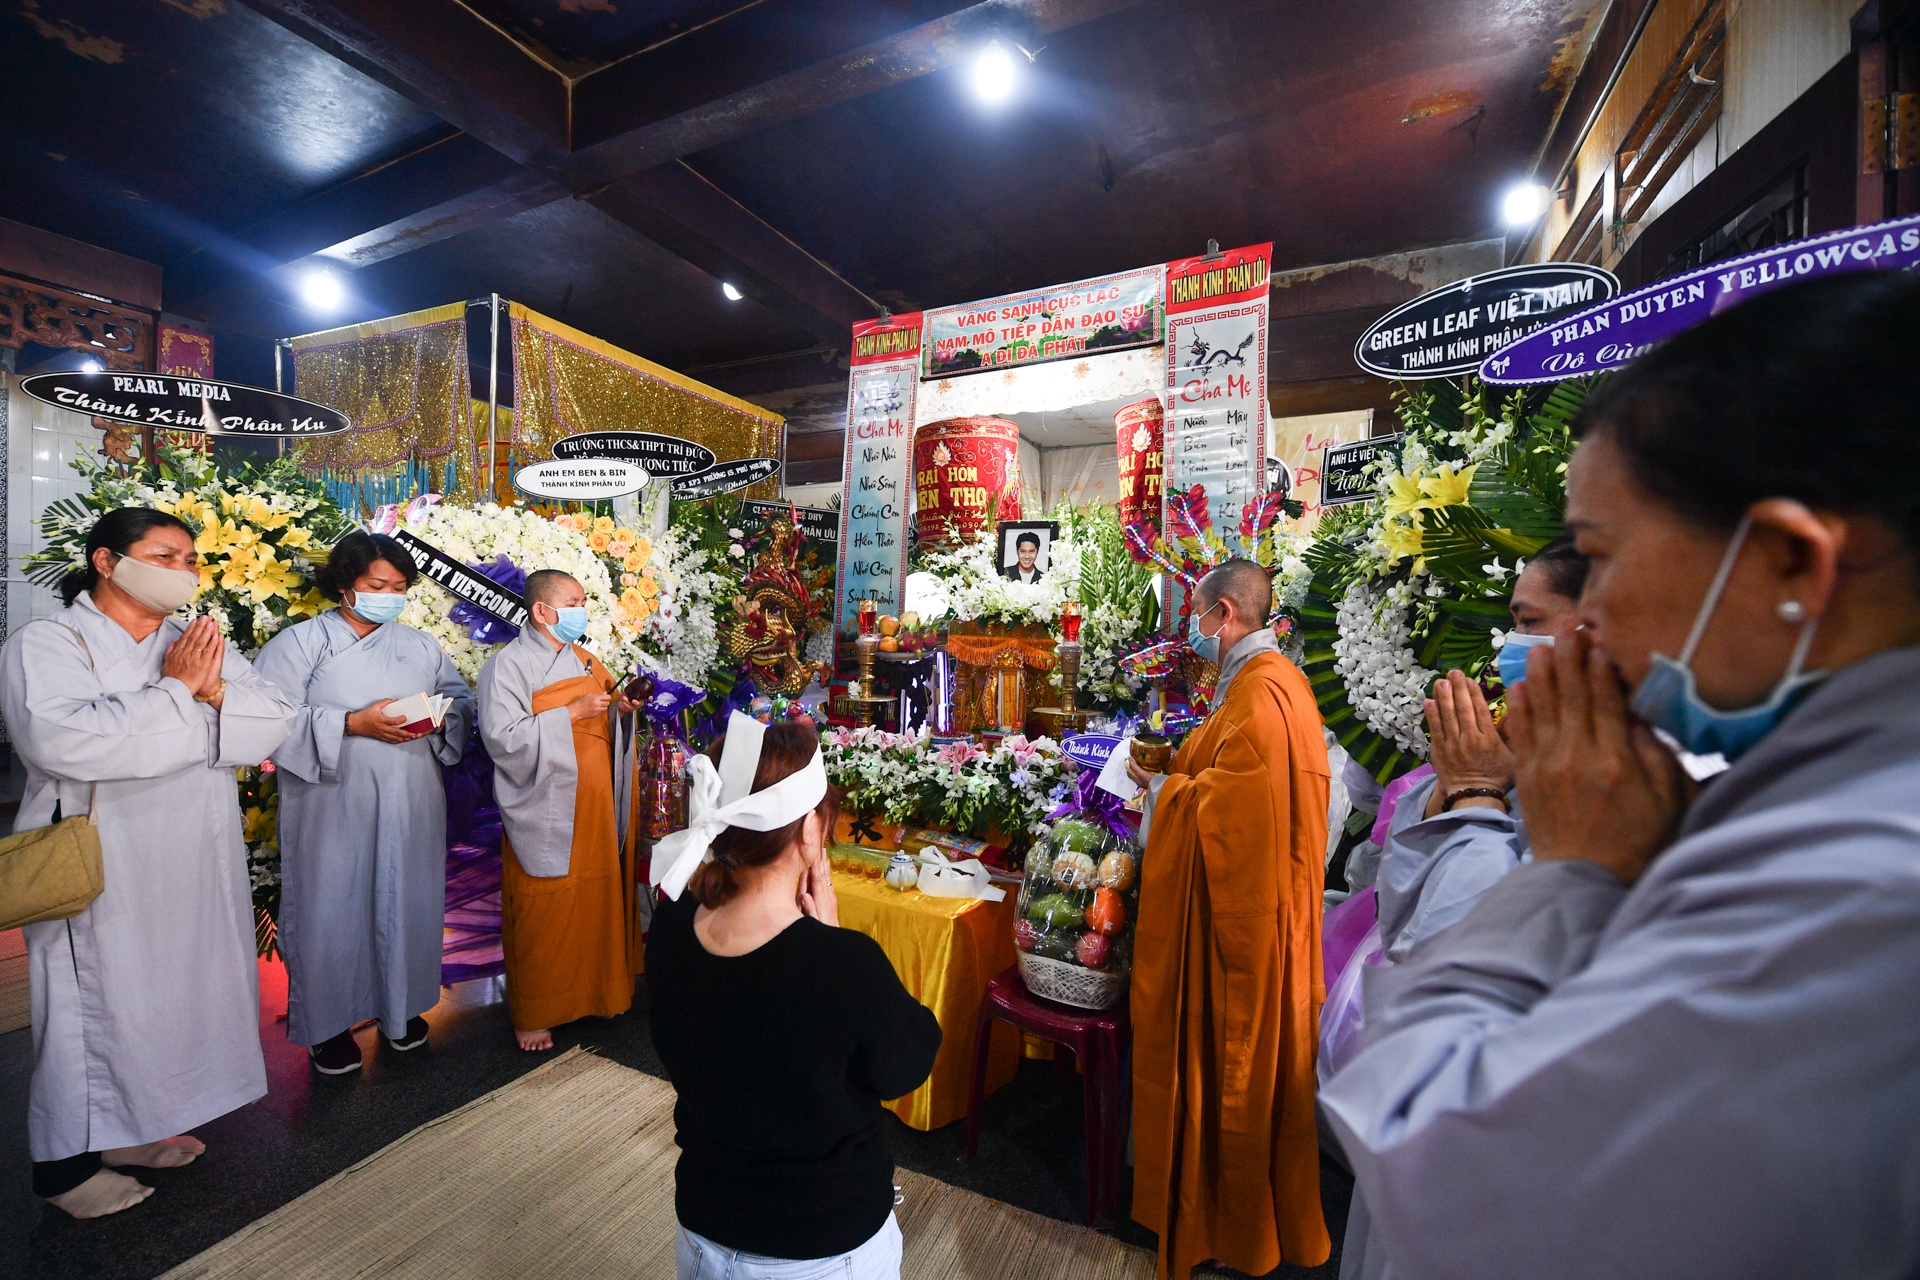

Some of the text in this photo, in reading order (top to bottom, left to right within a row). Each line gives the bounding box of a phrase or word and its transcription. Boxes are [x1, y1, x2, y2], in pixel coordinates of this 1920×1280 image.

[1171, 270, 1200, 304] THÀNH
[1203, 265, 1224, 298] KÍNH
[1226, 258, 1251, 294] PHÂN
[957, 285, 1120, 328] VÃNG SANH CỰC LẠC
[1370, 277, 1595, 352] GREEN LEAF VIỆT NAM
[1550, 312, 1611, 347] PHAN
[1619, 279, 1705, 325] DUYEN
[876, 328, 891, 355] KÍNH
[891, 325, 908, 353] PHÂN
[936, 335, 967, 353] NAM
[972, 329, 996, 346] MÔ
[1001, 320, 1037, 342] TIẾP
[1042, 313, 1075, 334] DẪN
[1081, 309, 1116, 330] ĐẠO
[981, 352, 992, 366] A
[996, 349, 1012, 364] DI
[1017, 342, 1039, 361] ĐÀ
[1402, 341, 1443, 370] THÀNH
[1447, 336, 1479, 362] KÍNH
[1542, 351, 1587, 374] Vô
[112, 376, 232, 401] PEARL MEDIA
[1180, 374, 1253, 403] Cha Mẹ
[54, 386, 327, 432] Thành Kính Phân Ưu
[1227, 409, 1248, 433] Mây
[857, 420, 884, 439] Cha
[561, 437, 707, 461] TRƯỜNG THCS&THPT TRÍ ĐỨC
[881, 446, 897, 461] Núi
[1331, 453, 1347, 466] ANH
[1348, 449, 1358, 464] LÊ
[1359, 446, 1376, 462] VIỆT
[539, 469, 626, 477] ANH EM BEN & BIN
[672, 458, 697, 473] TIẾC
[541, 480, 626, 488] THÀNH KÍNH PHÂN ƯU
[877, 474, 897, 503] Sông
[851, 504, 900, 532] Chúng Con
[875, 532, 895, 548] Thảo
[427, 558, 452, 582] TY
[448, 570, 515, 618] VIETCOM
[870, 561, 893, 589] Công
[1067, 740, 1110, 758] Thành Kính
